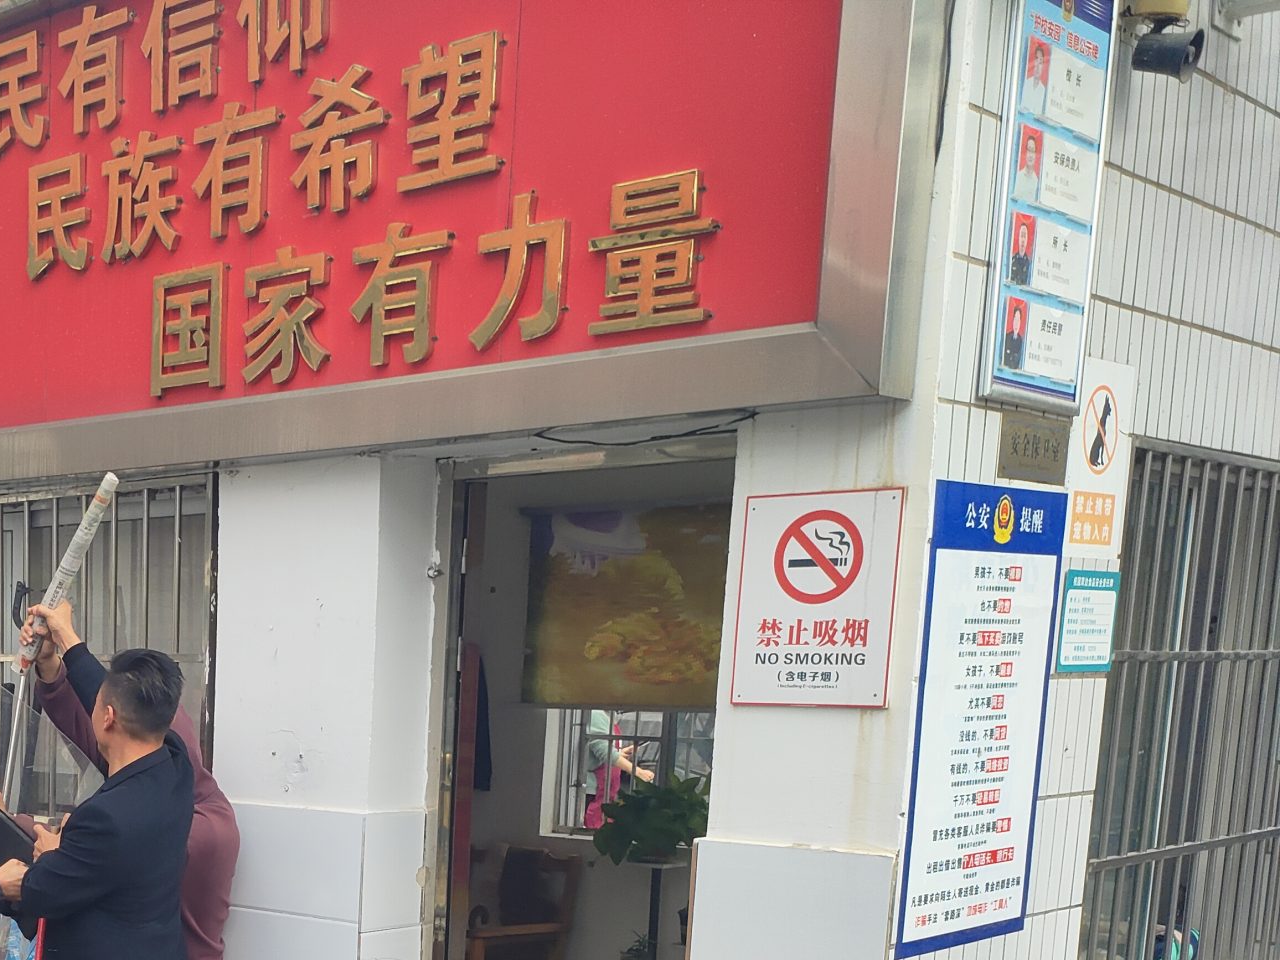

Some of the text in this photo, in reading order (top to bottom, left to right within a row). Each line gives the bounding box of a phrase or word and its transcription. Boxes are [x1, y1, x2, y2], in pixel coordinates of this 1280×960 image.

[24, 29, 508, 281] 民族有希望
[149, 168, 720, 398] 国家有力量
[965, 501, 1044, 534] 公安 提醒
[1073, 520, 1110, 542] 宠物入内
[755, 618, 870, 648] 禁止吸烟
[755, 652, 867, 666] NO SMOKING
